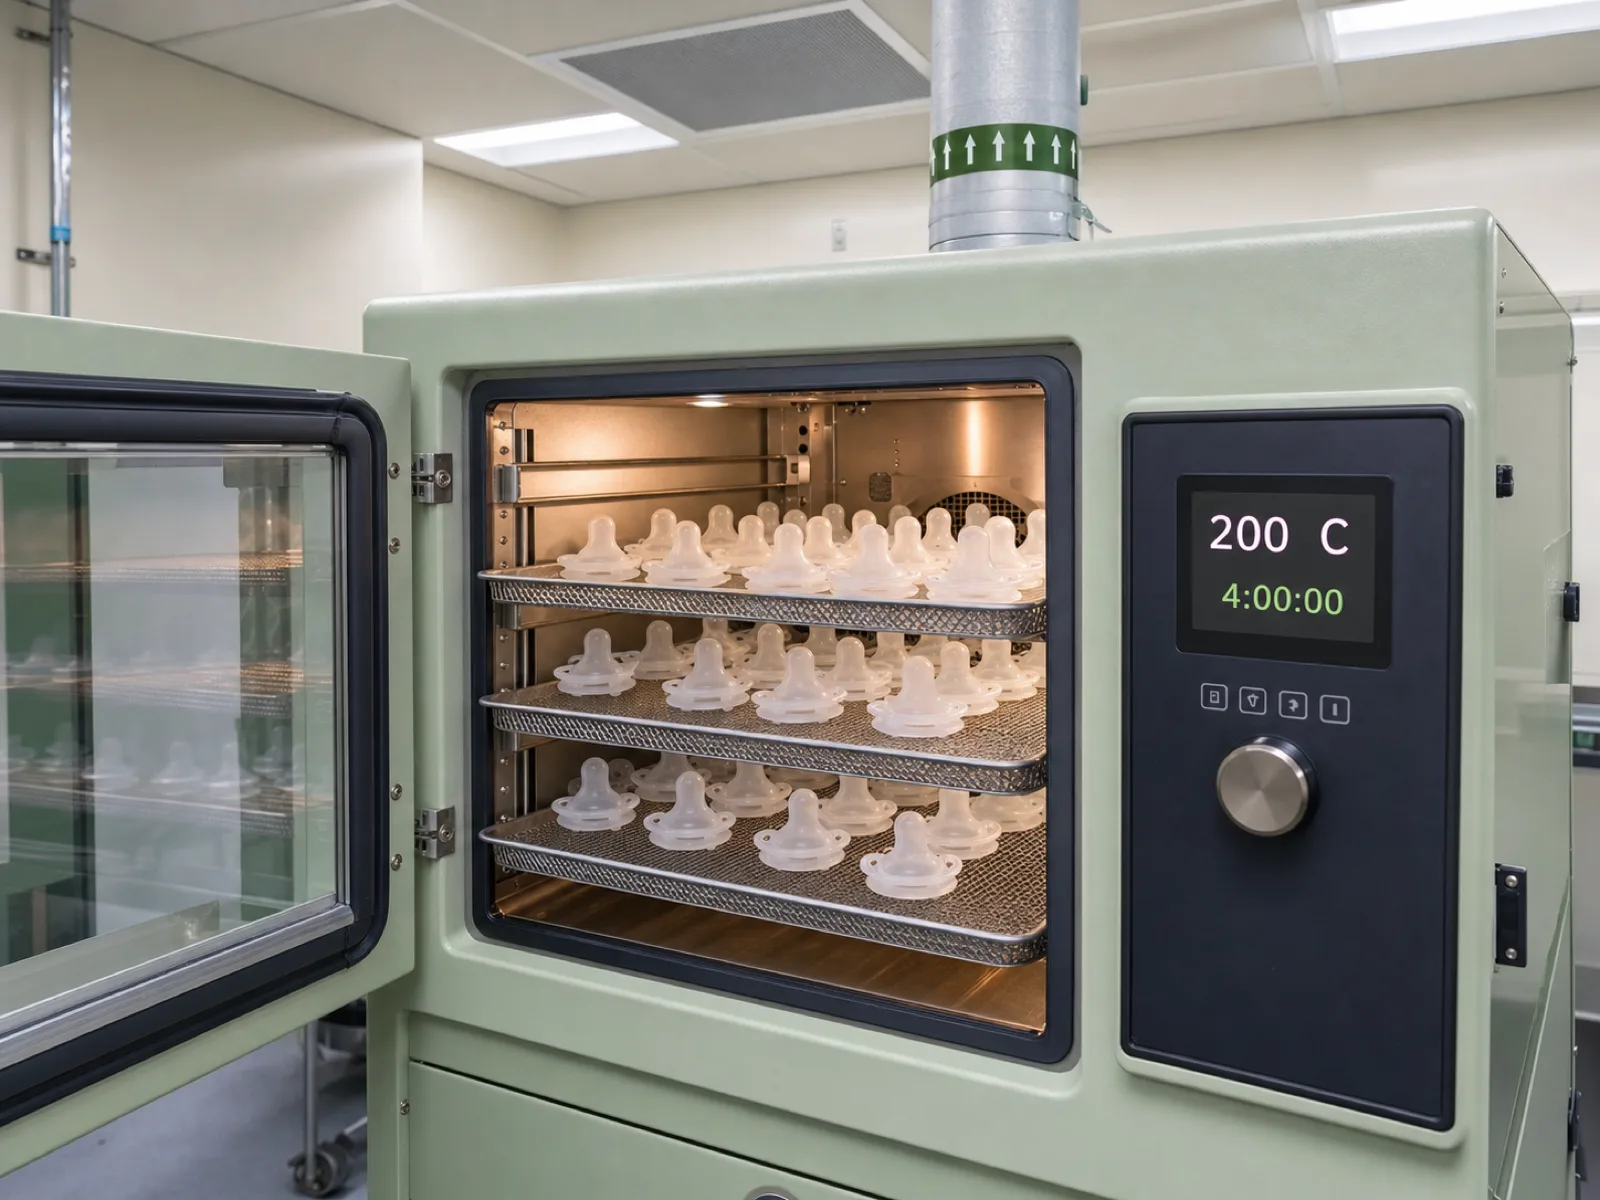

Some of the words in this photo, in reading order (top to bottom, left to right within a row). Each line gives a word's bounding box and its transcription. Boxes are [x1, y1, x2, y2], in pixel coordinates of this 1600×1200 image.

[1209, 514, 1289, 553] 200
[1320, 517, 1349, 556] C
[1221, 582, 1343, 615] 4:00:00
